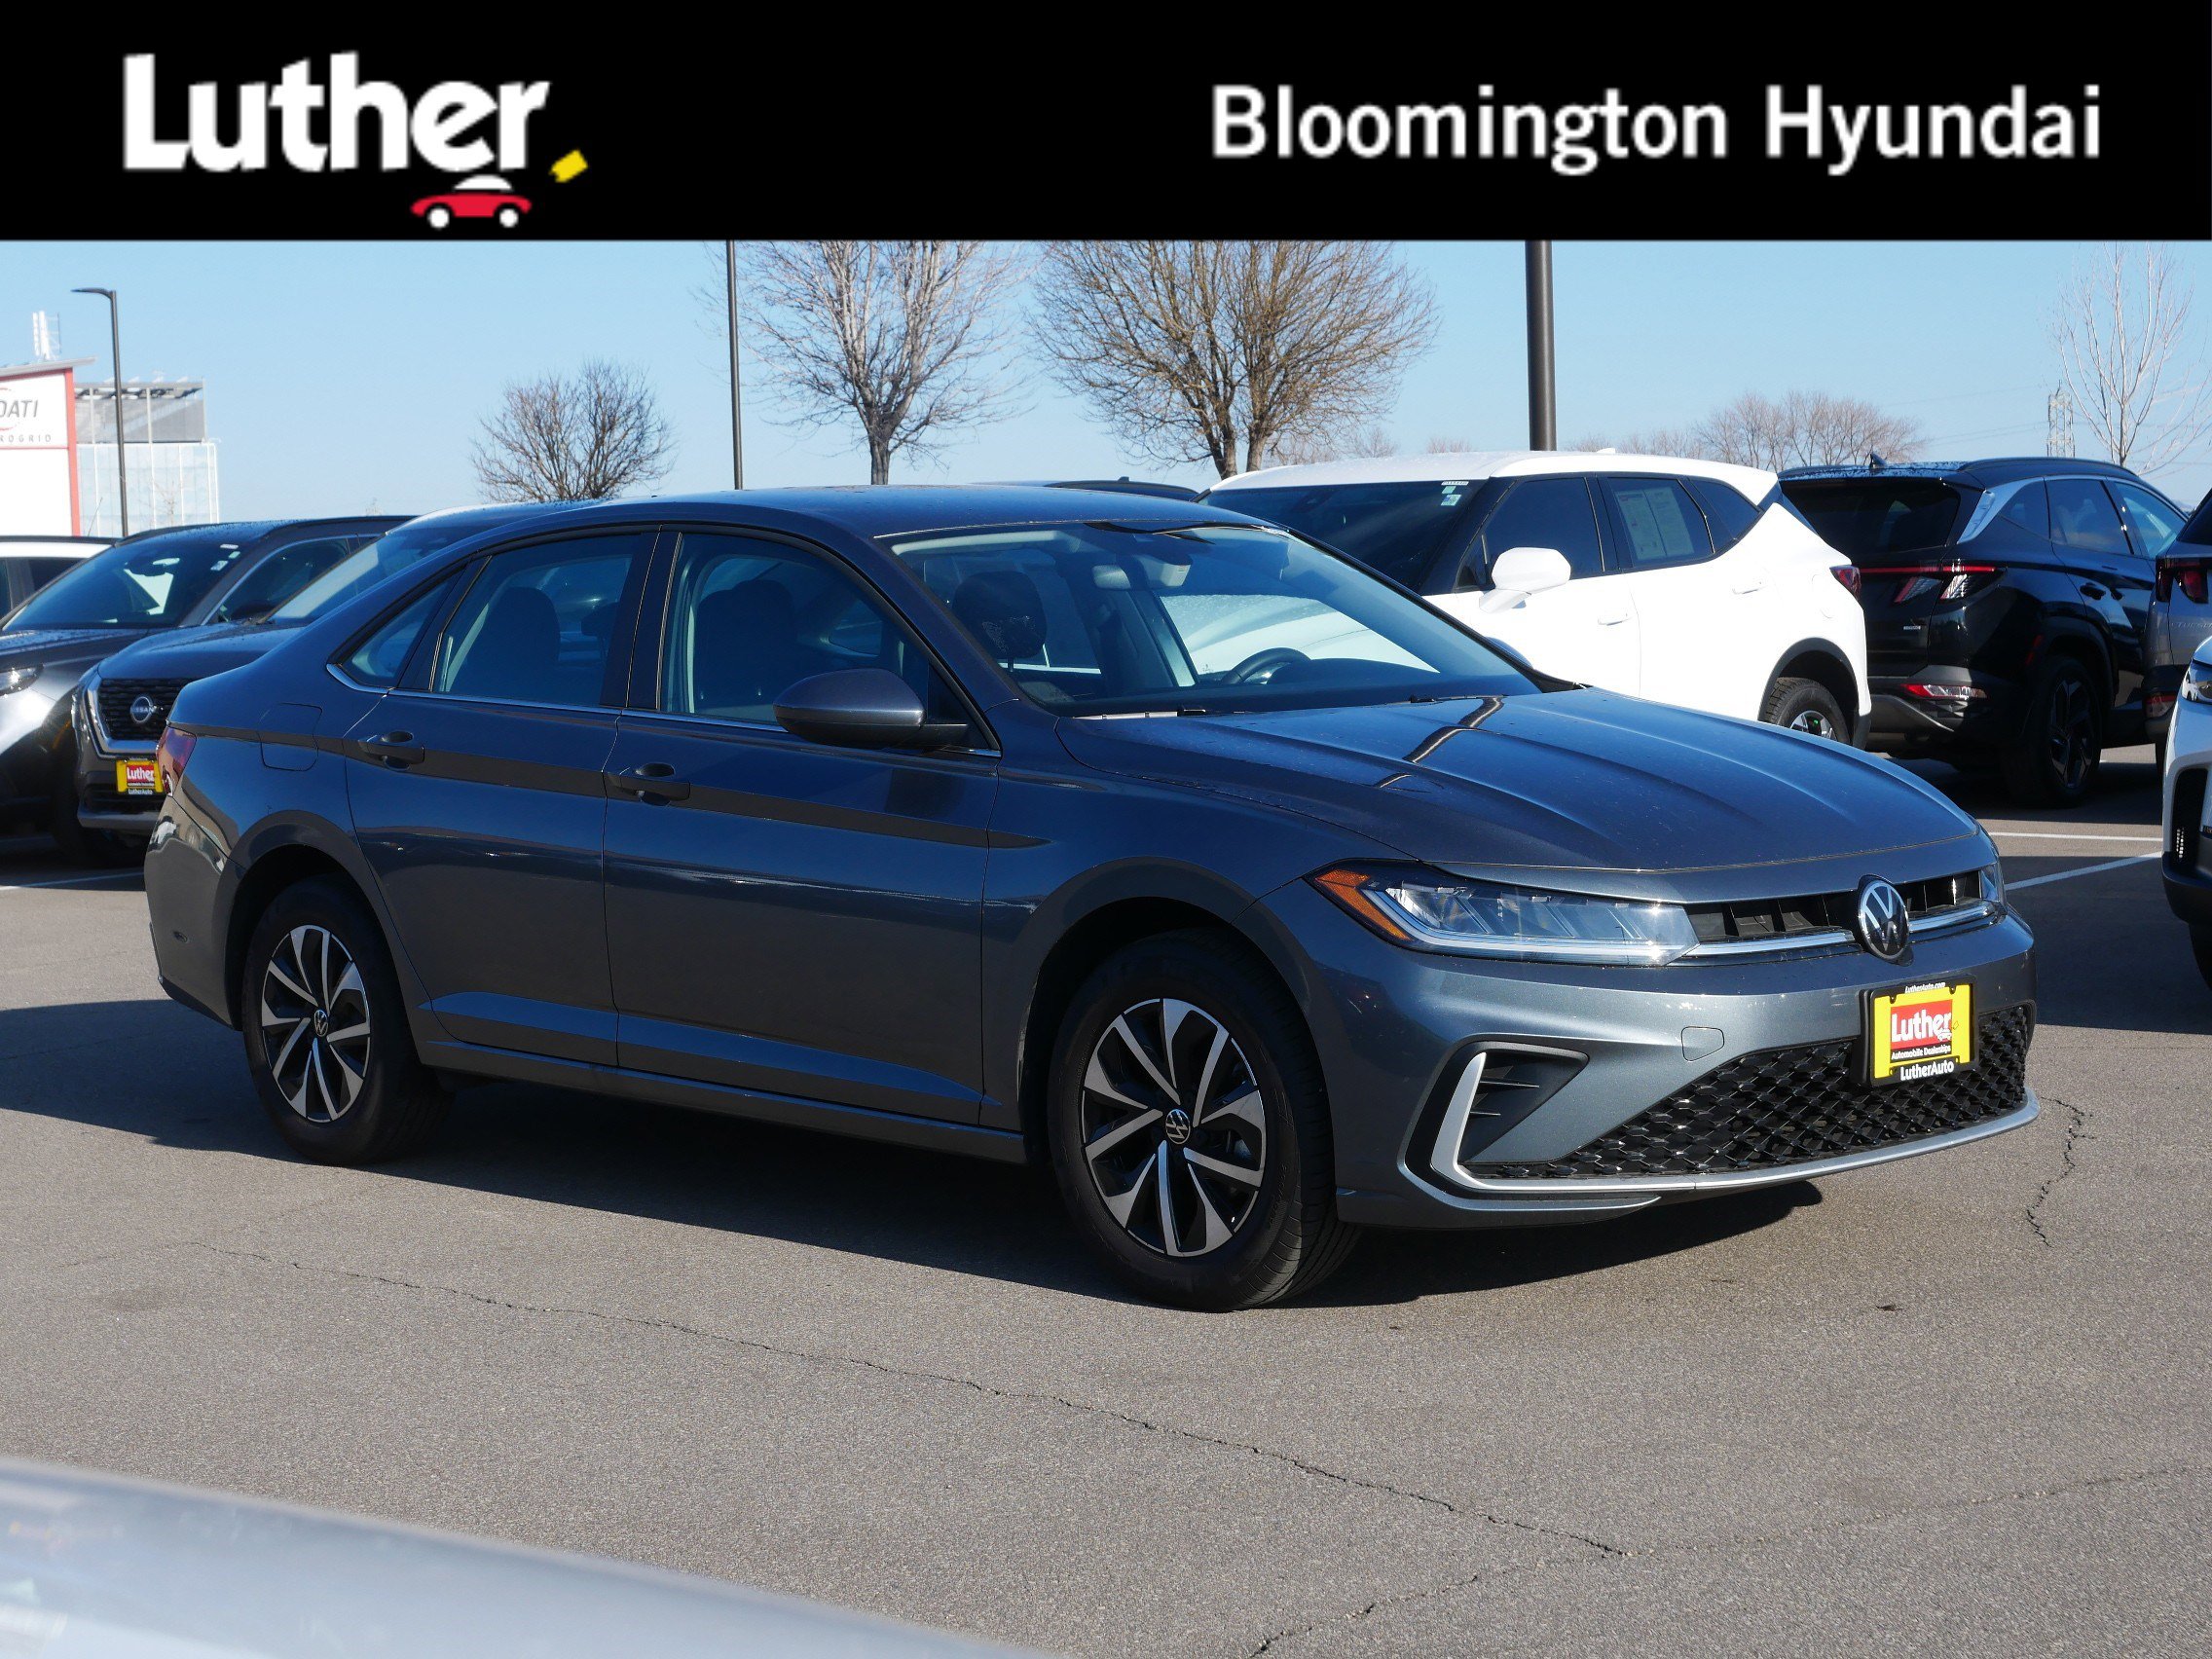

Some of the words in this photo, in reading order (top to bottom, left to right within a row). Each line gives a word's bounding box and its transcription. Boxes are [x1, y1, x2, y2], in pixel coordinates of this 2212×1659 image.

[127, 767, 154, 780] Luther
[1891, 1009, 1952, 1043] Luther
[1891, 1048, 1923, 1060] Automobile
[1923, 1044, 1951, 1056] Dealerships
[1899, 1059, 1955, 1082] LutherAuto
